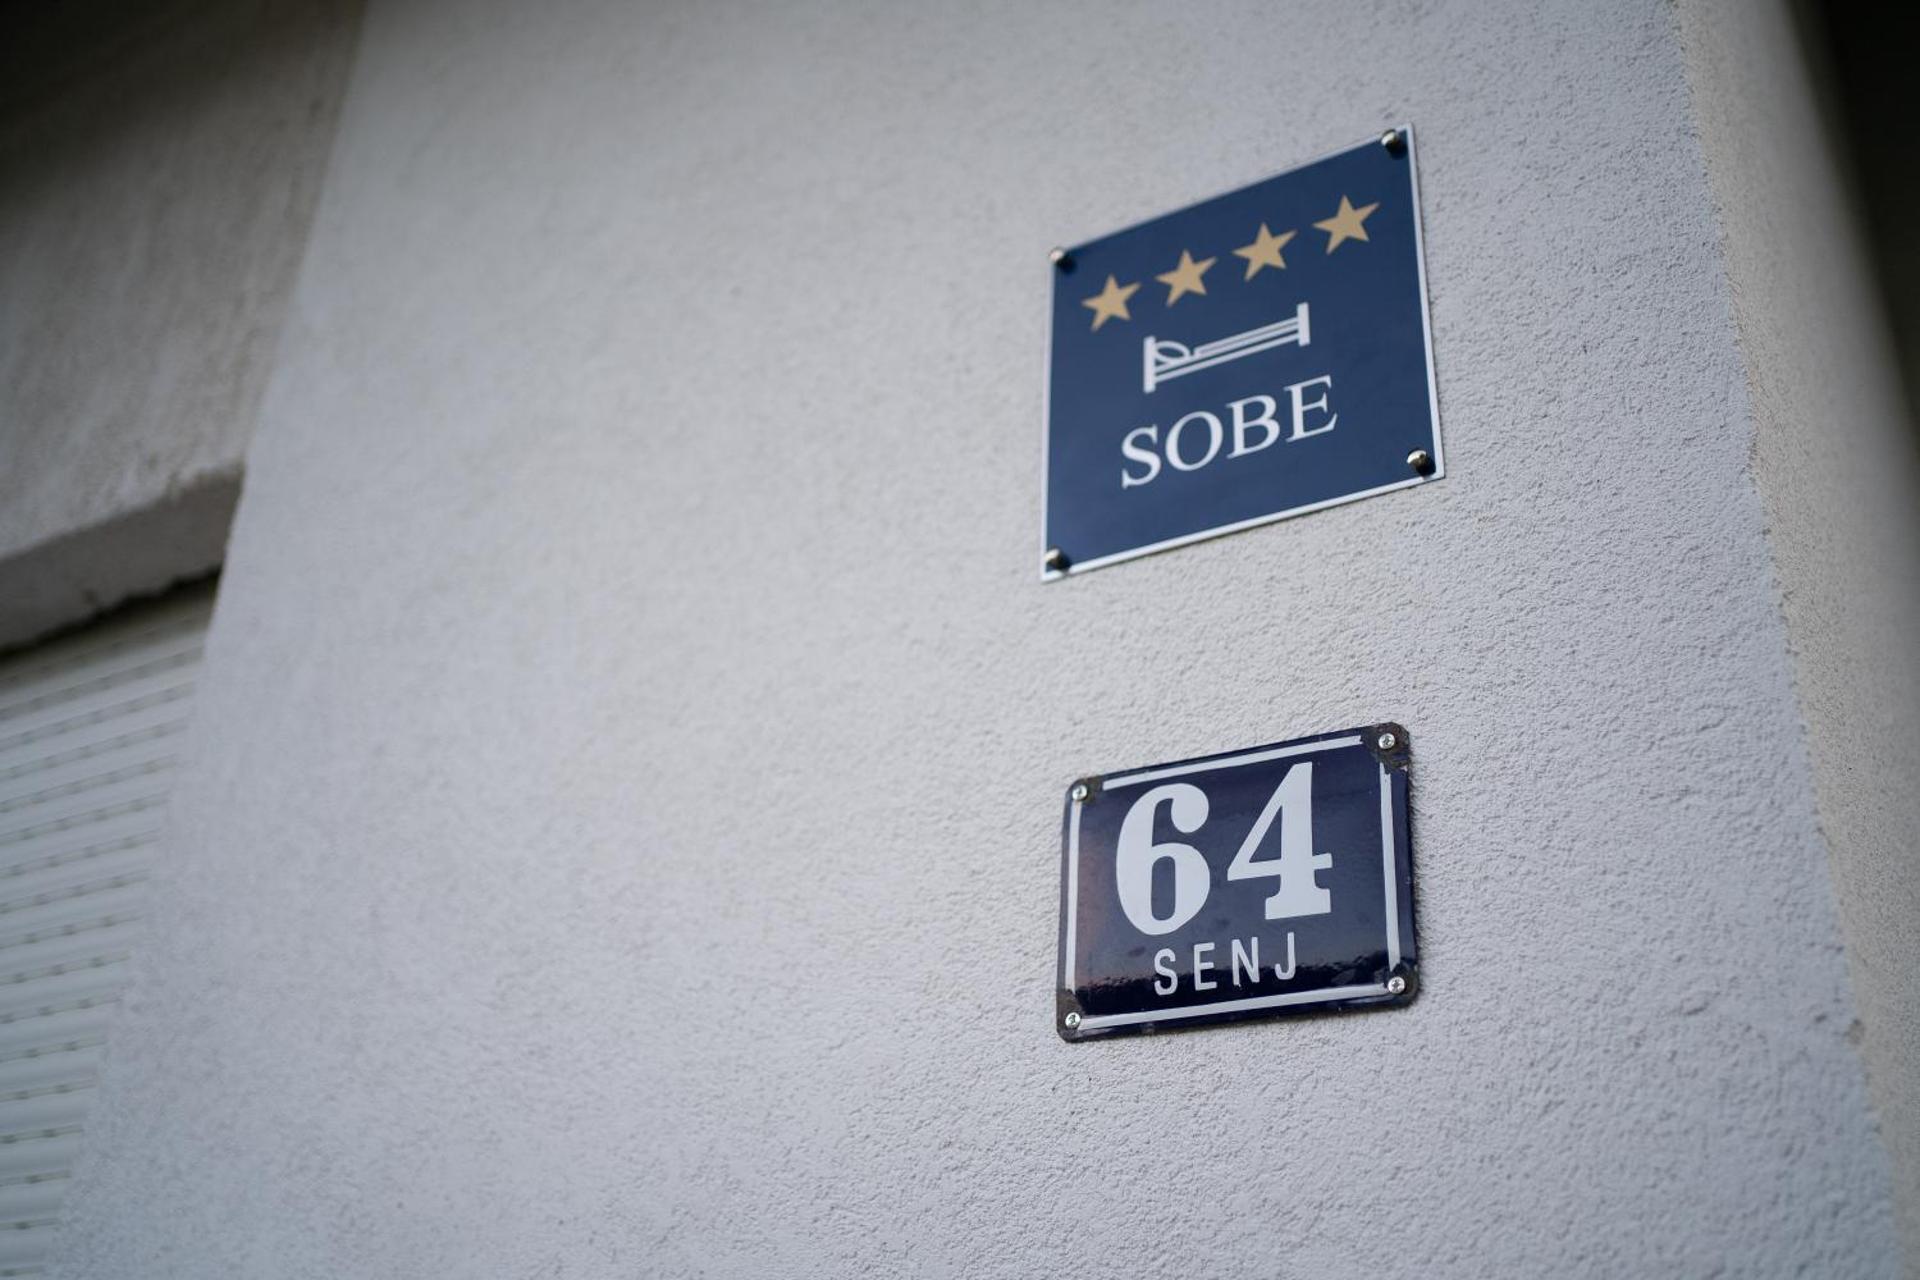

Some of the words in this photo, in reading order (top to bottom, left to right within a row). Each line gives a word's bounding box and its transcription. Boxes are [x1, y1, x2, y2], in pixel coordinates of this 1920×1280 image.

[1121, 374, 1338, 489] SOBE
[1115, 761, 1333, 936] 64
[1153, 931, 1296, 996] SENJ
